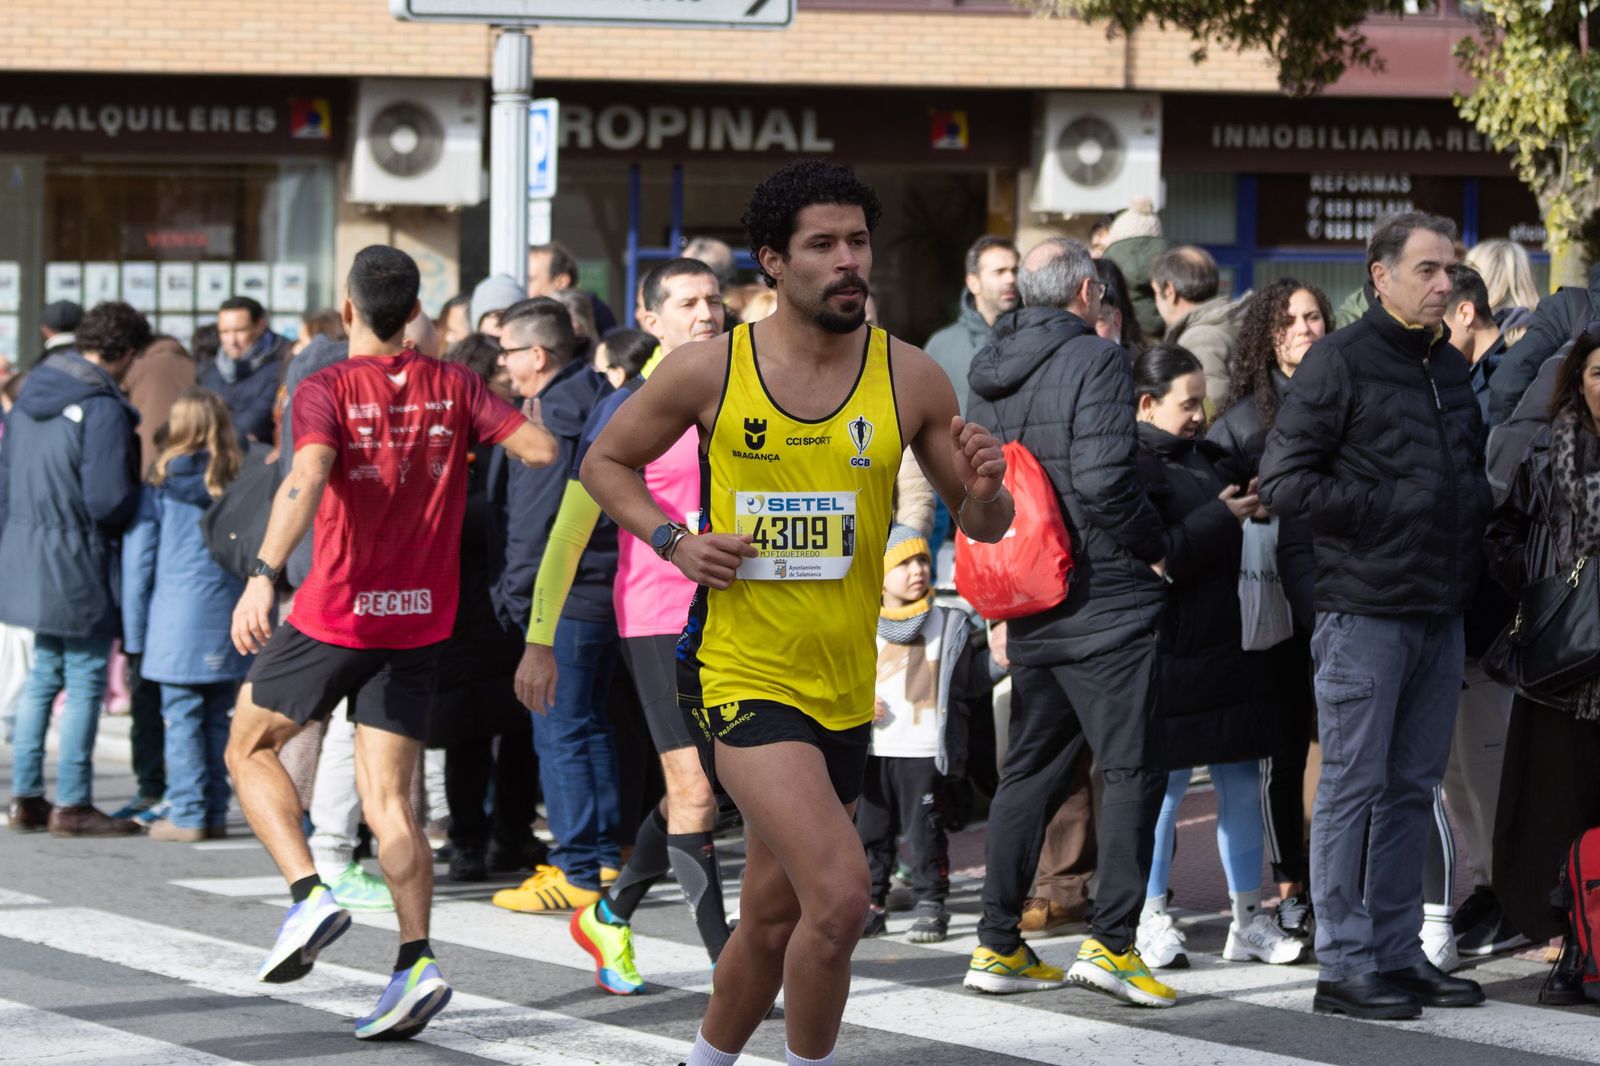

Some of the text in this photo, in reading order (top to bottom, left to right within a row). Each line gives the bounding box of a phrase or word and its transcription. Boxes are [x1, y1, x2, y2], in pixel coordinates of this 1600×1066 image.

[1310, 173, 1412, 193] REFORMAS
[803, 436, 832, 445] SPORT
[732, 450, 780, 462] BRAGANÇA
[851, 457, 870, 467] GCB
[767, 497, 844, 512] SETEL
[752, 516, 828, 550] 4309
[357, 590, 430, 614] PECHIS
